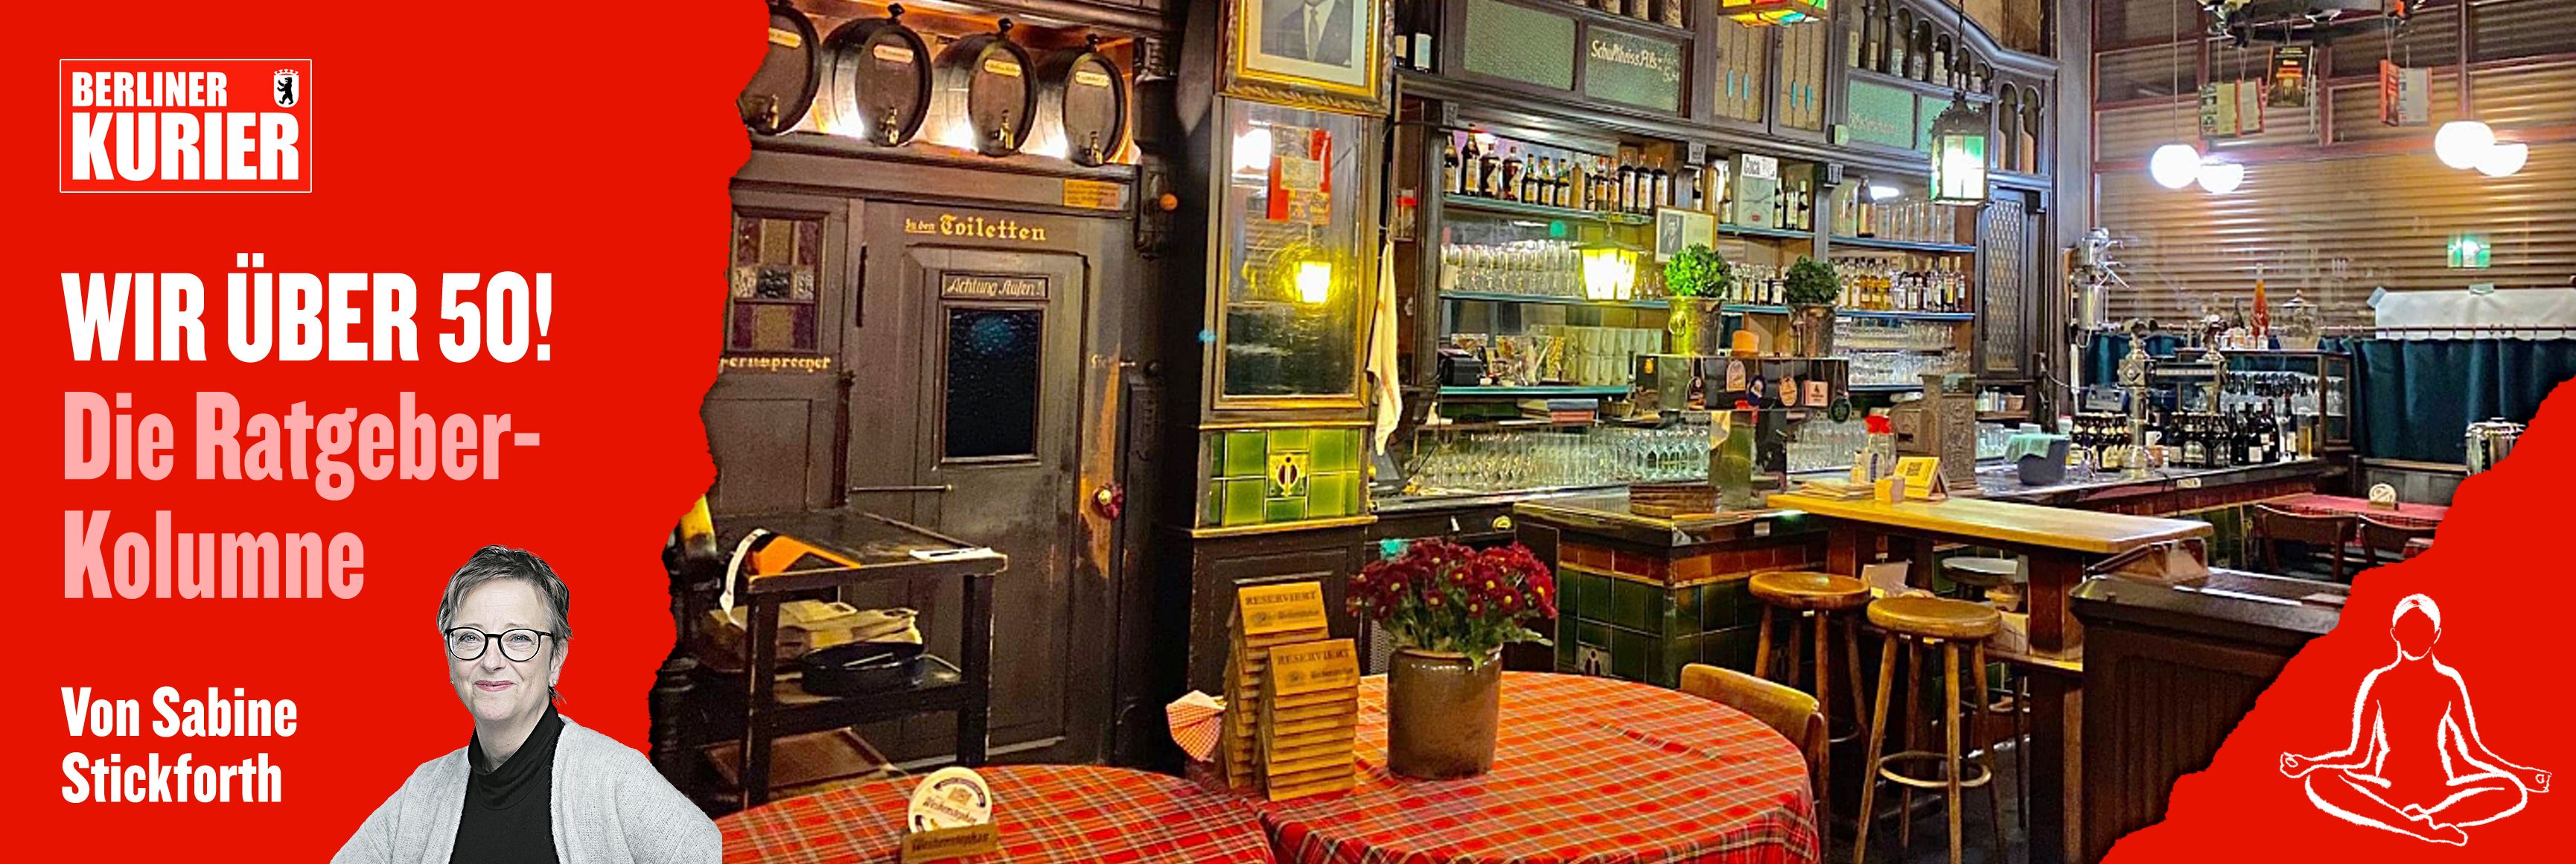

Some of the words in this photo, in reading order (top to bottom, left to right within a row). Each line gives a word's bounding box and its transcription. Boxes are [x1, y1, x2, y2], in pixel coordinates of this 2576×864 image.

[940, 214, 1046, 241] Toiletten
[946, 277, 998, 296] Achtung
[1246, 591, 1317, 606] RESERVIERT
[1278, 649, 1351, 665] RESERVIERT
